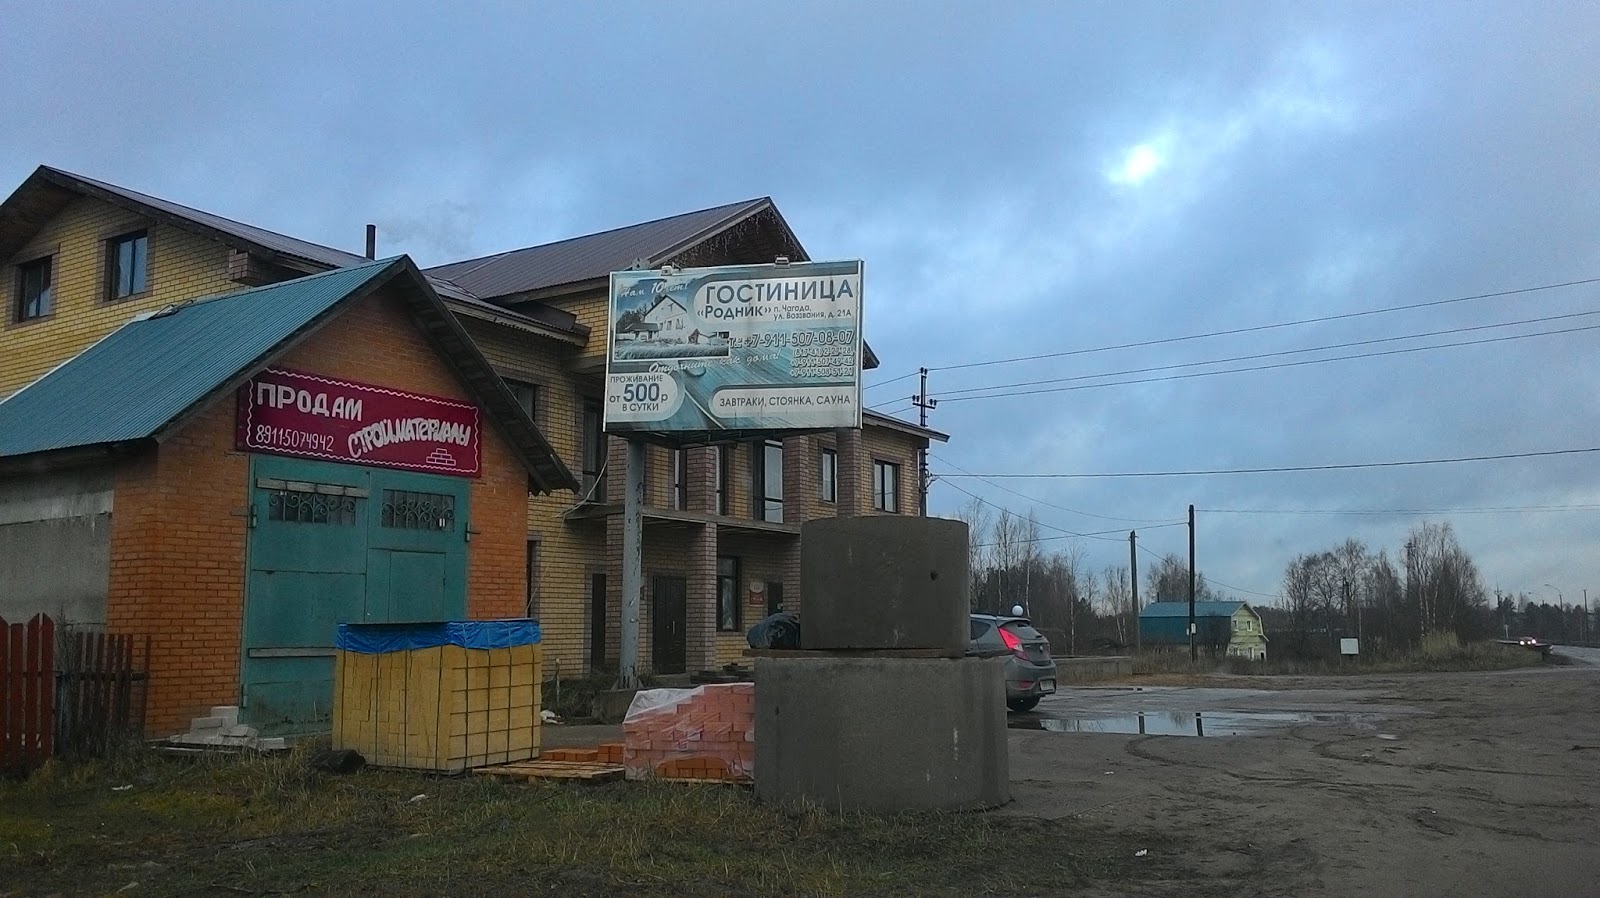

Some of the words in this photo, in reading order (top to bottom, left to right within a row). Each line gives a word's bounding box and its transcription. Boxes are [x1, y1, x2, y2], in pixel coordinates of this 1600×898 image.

[651, 281, 666, 294] 10
[705, 279, 854, 304] ГОСТИНИЦА
[773, 313, 785, 321] ул.
[786, 311, 827, 320] Воззвания,
[828, 311, 836, 319] д.
[837, 309, 852, 317] 21А
[782, 304, 812, 313] Чагода,
[744, 330, 855, 349] +7-911-507-08-07
[719, 355, 740, 366] как
[746, 347, 782, 366] дома!
[610, 374, 664, 383] ПРОЖИВАНИЕ
[623, 382, 660, 403] 500
[257, 382, 363, 422] ПРОДАМ
[622, 402, 628, 411] В
[630, 401, 659, 412] СУТКИ
[719, 397, 767, 408] ЗАВТРАКИ,
[768, 396, 815, 407] СТОЯНКА,
[816, 394, 851, 405] САУНА
